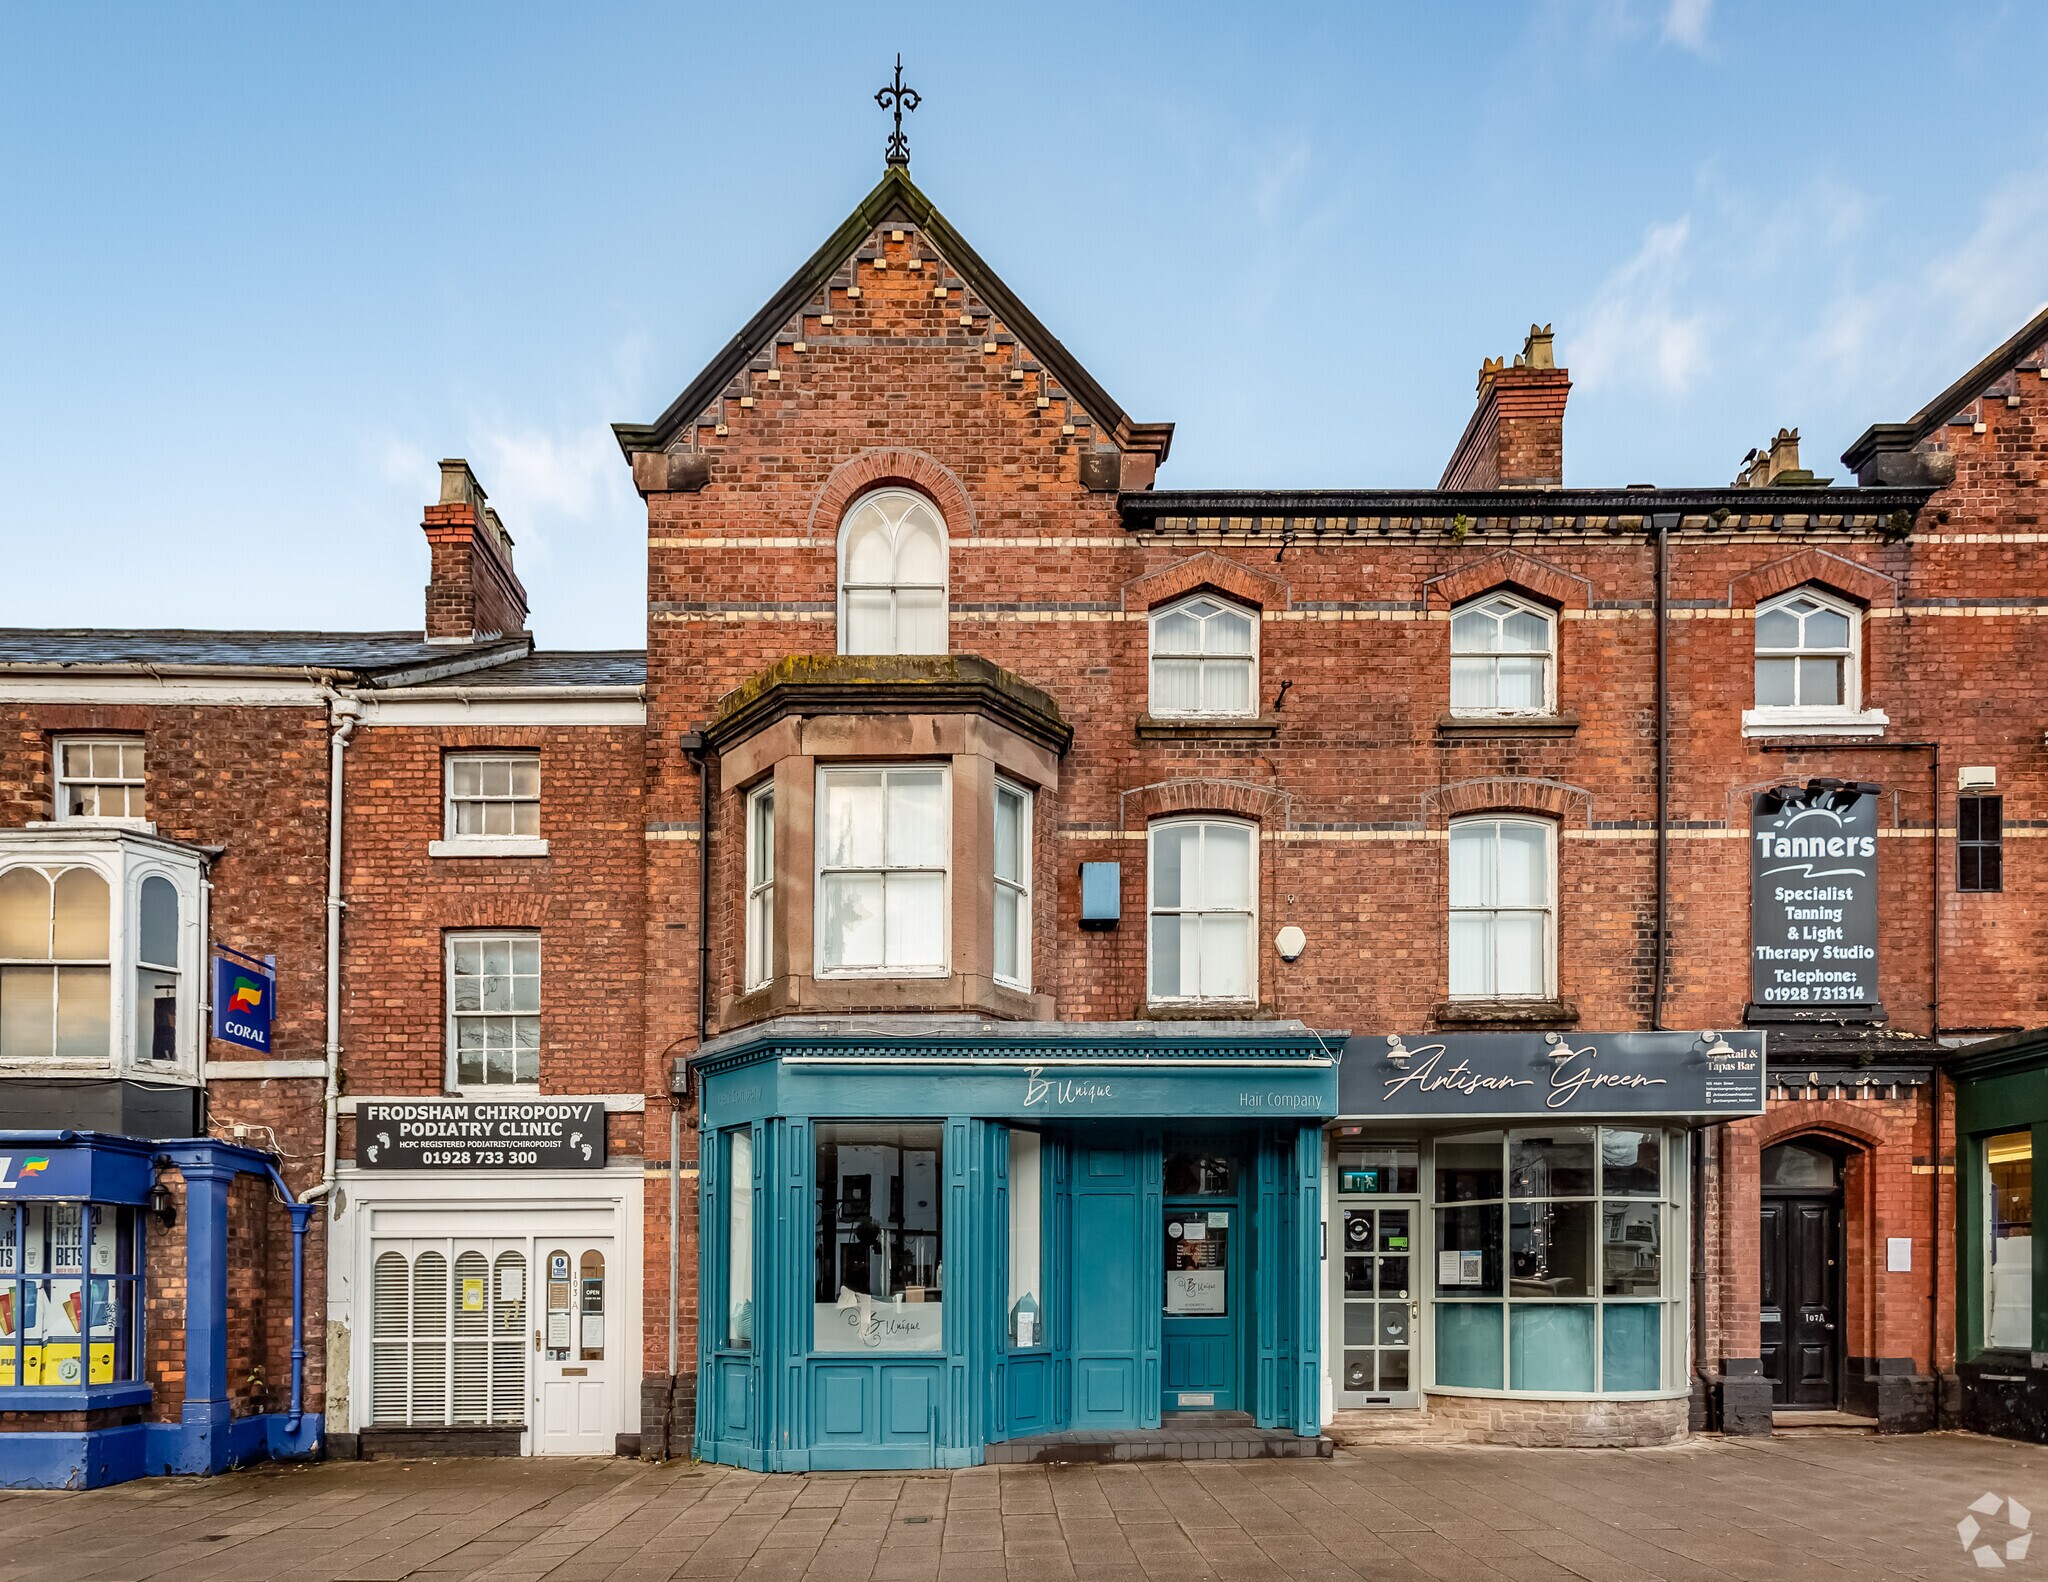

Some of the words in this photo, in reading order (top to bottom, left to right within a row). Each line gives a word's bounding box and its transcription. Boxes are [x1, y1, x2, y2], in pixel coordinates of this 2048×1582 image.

[1756, 831, 1876, 858] Tanners
[1774, 886, 1854, 904] Specialist
[1785, 906, 1843, 923] Tanning
[1787, 926, 1800, 940] &
[1803, 926, 1843, 943] Light
[1756, 945, 1820, 962] Therapy
[1822, 945, 1875, 960] Studio
[1774, 968, 1857, 985] Telephone:
[1764, 987, 1810, 1001] 01928
[1813, 986, 1865, 1000] 731314
[225, 1021, 265, 1043] CORAL
[1749, 1050, 1758, 1058] &
[1706, 1061, 1736, 1073] Tapas
[1737, 1061, 1756, 1071] Bar
[1383, 1045, 1534, 1101] Artisan
[1545, 1046, 1667, 1108] Green
[1057, 1080, 1113, 1104] Unique
[1240, 1092, 1263, 1107] Hair
[1267, 1092, 1323, 1110] Company
[367, 1105, 469, 1121] FRODSHAM
[474, 1105, 593, 1122] CHIROPODY/
[400, 1122, 494, 1137] PODIATRY
[499, 1121, 563, 1136] CLINIC
[399, 1140, 419, 1148] HCPC
[420, 1140, 466, 1148] REGISTERED
[467, 1140, 562, 1149] PODIATRIST/CHIROPODIST
[422, 1151, 471, 1164] 01928
[476, 1151, 504, 1164] 733
[508, 1151, 538, 1164] 300
[56, 1227, 69, 1246] IN
[56, 1247, 83, 1266] BETS
[1805, 1313, 1825, 1323] 107A
[886, 1319, 921, 1335] Unique
